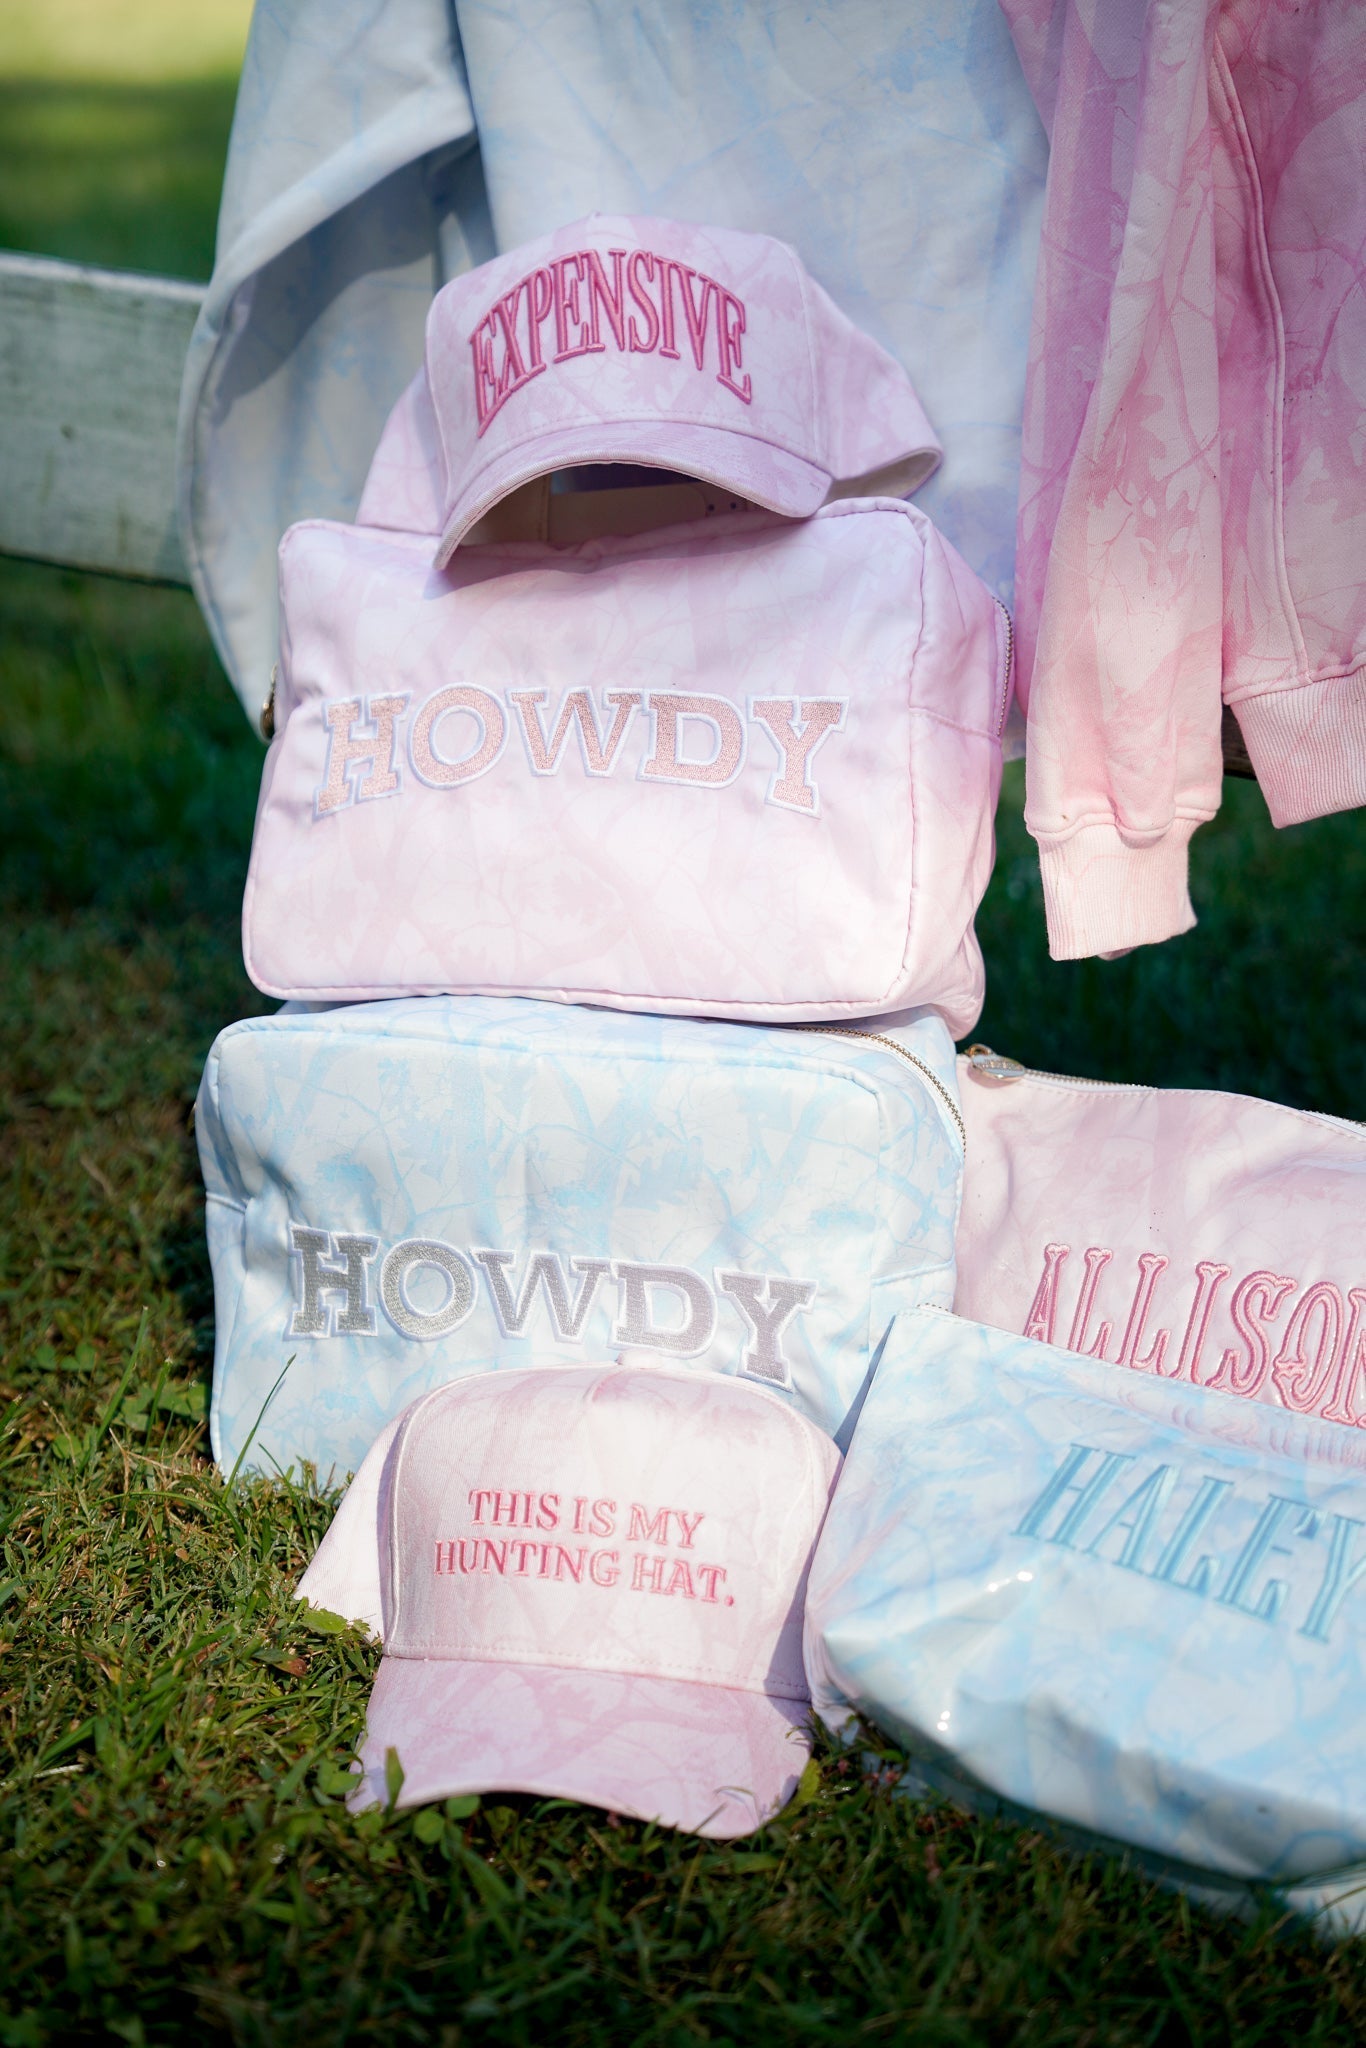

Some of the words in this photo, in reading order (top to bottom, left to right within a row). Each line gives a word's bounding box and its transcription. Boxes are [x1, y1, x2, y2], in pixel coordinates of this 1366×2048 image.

[468, 247, 752, 438] EXPENSIVE
[313, 681, 849, 820] HOWDY
[283, 1221, 818, 1391] HOWDY
[433, 1538, 621, 1588] HUNTING
[630, 1552, 736, 1607] HAT.
[468, 1488, 562, 1531] THIS
[573, 1497, 617, 1537] IS
[626, 1503, 705, 1549] MY
[1010, 1443, 1366, 1644] HALEY
